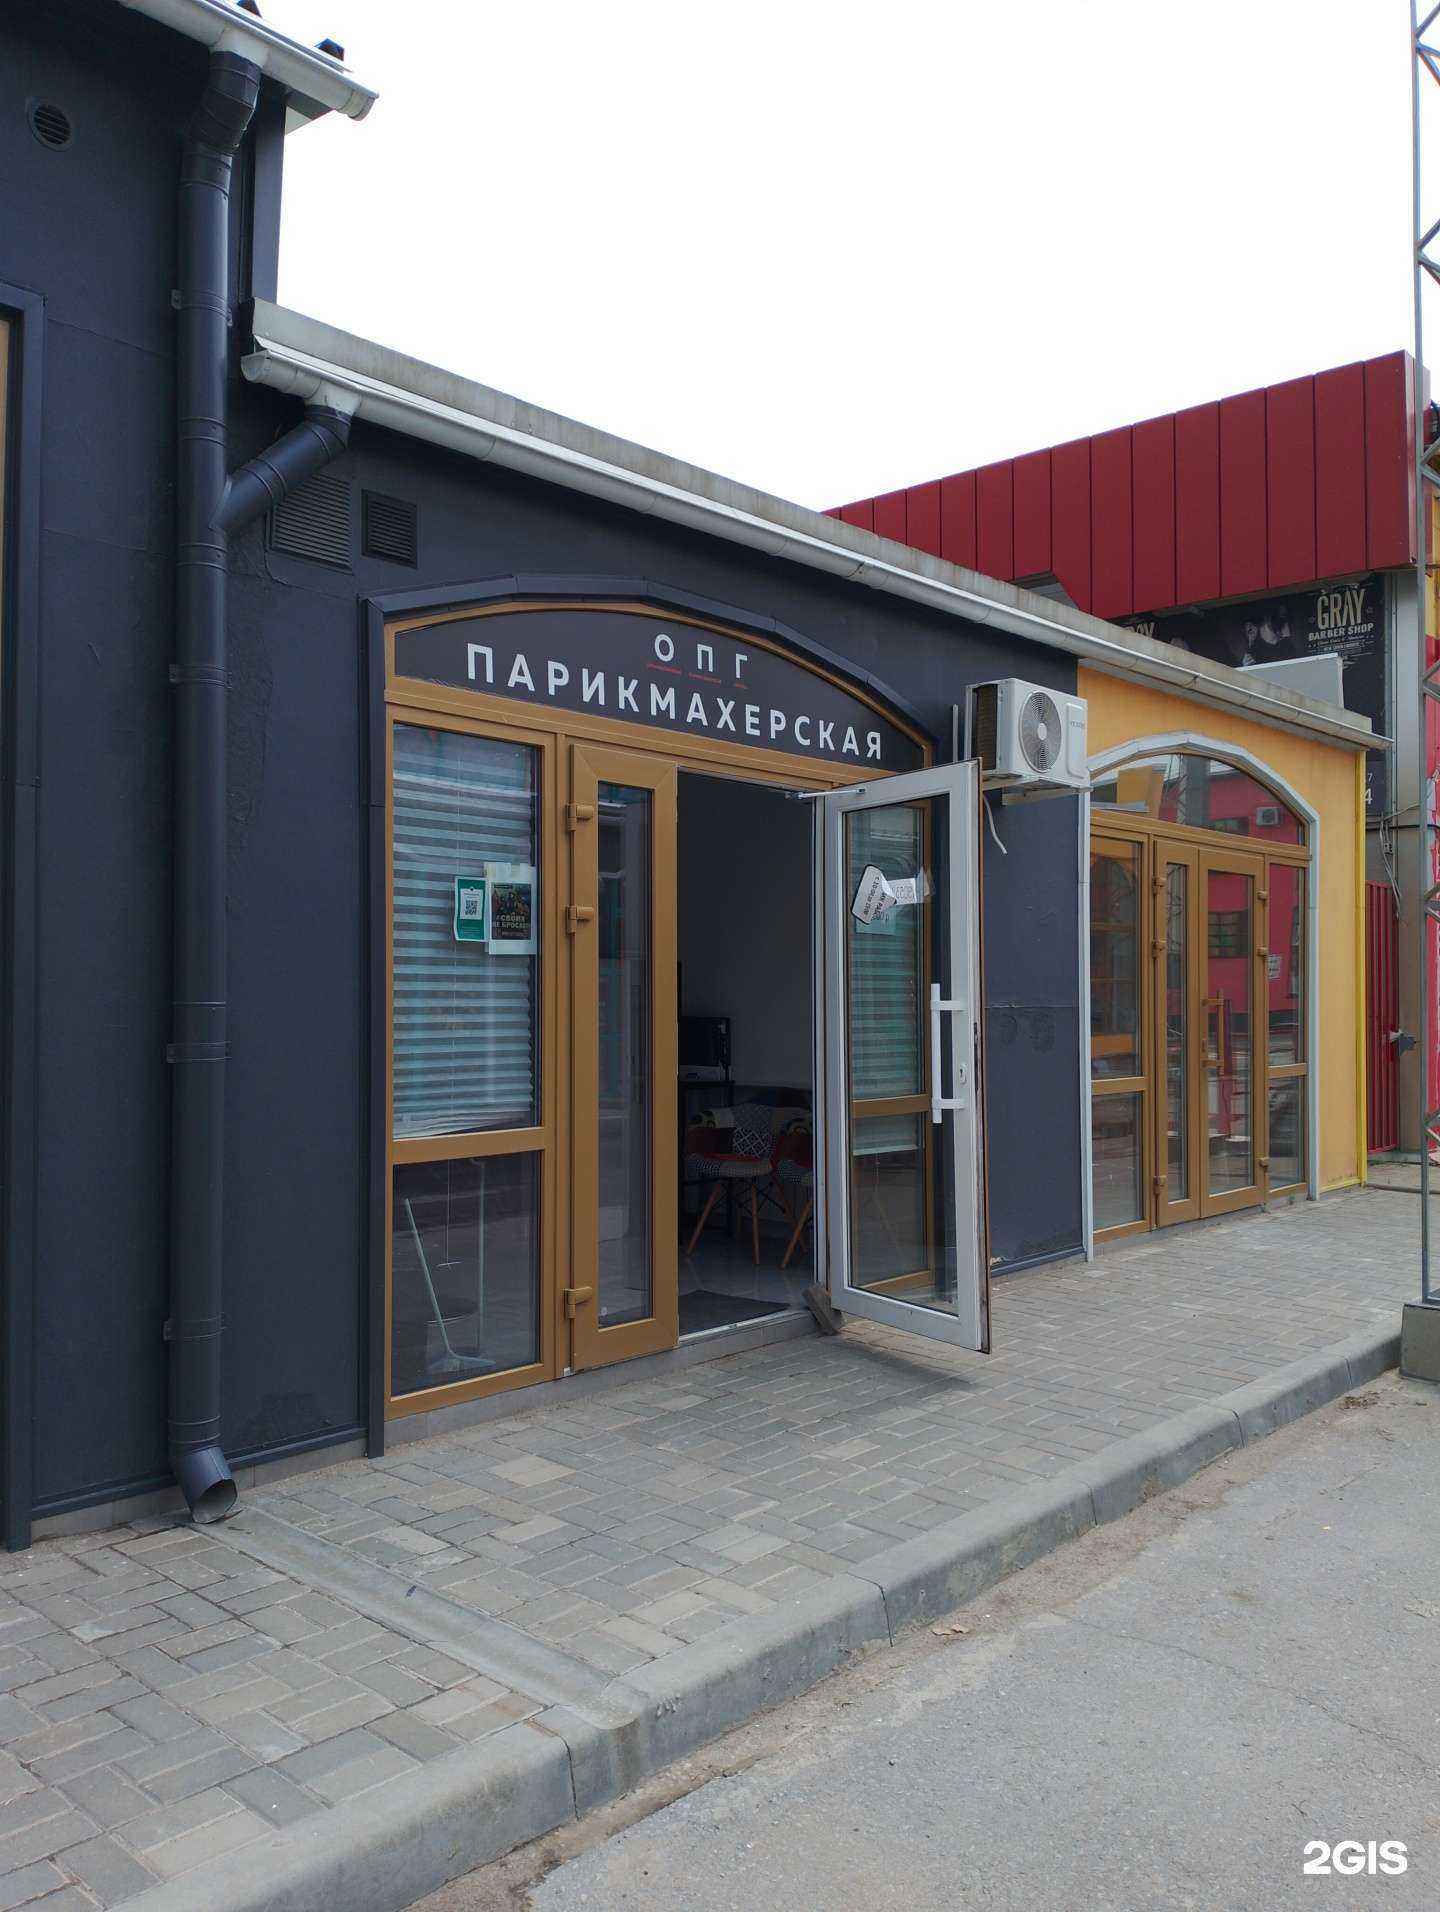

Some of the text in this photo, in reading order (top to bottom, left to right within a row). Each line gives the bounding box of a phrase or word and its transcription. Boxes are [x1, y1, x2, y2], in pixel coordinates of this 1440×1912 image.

[1317, 589, 1366, 630] GRAY
[1308, 627, 1346, 642] BARBER
[1347, 622, 1375, 636] SHOP
[467, 642, 882, 760] ПАРИКМАХЕРСКАЯ
